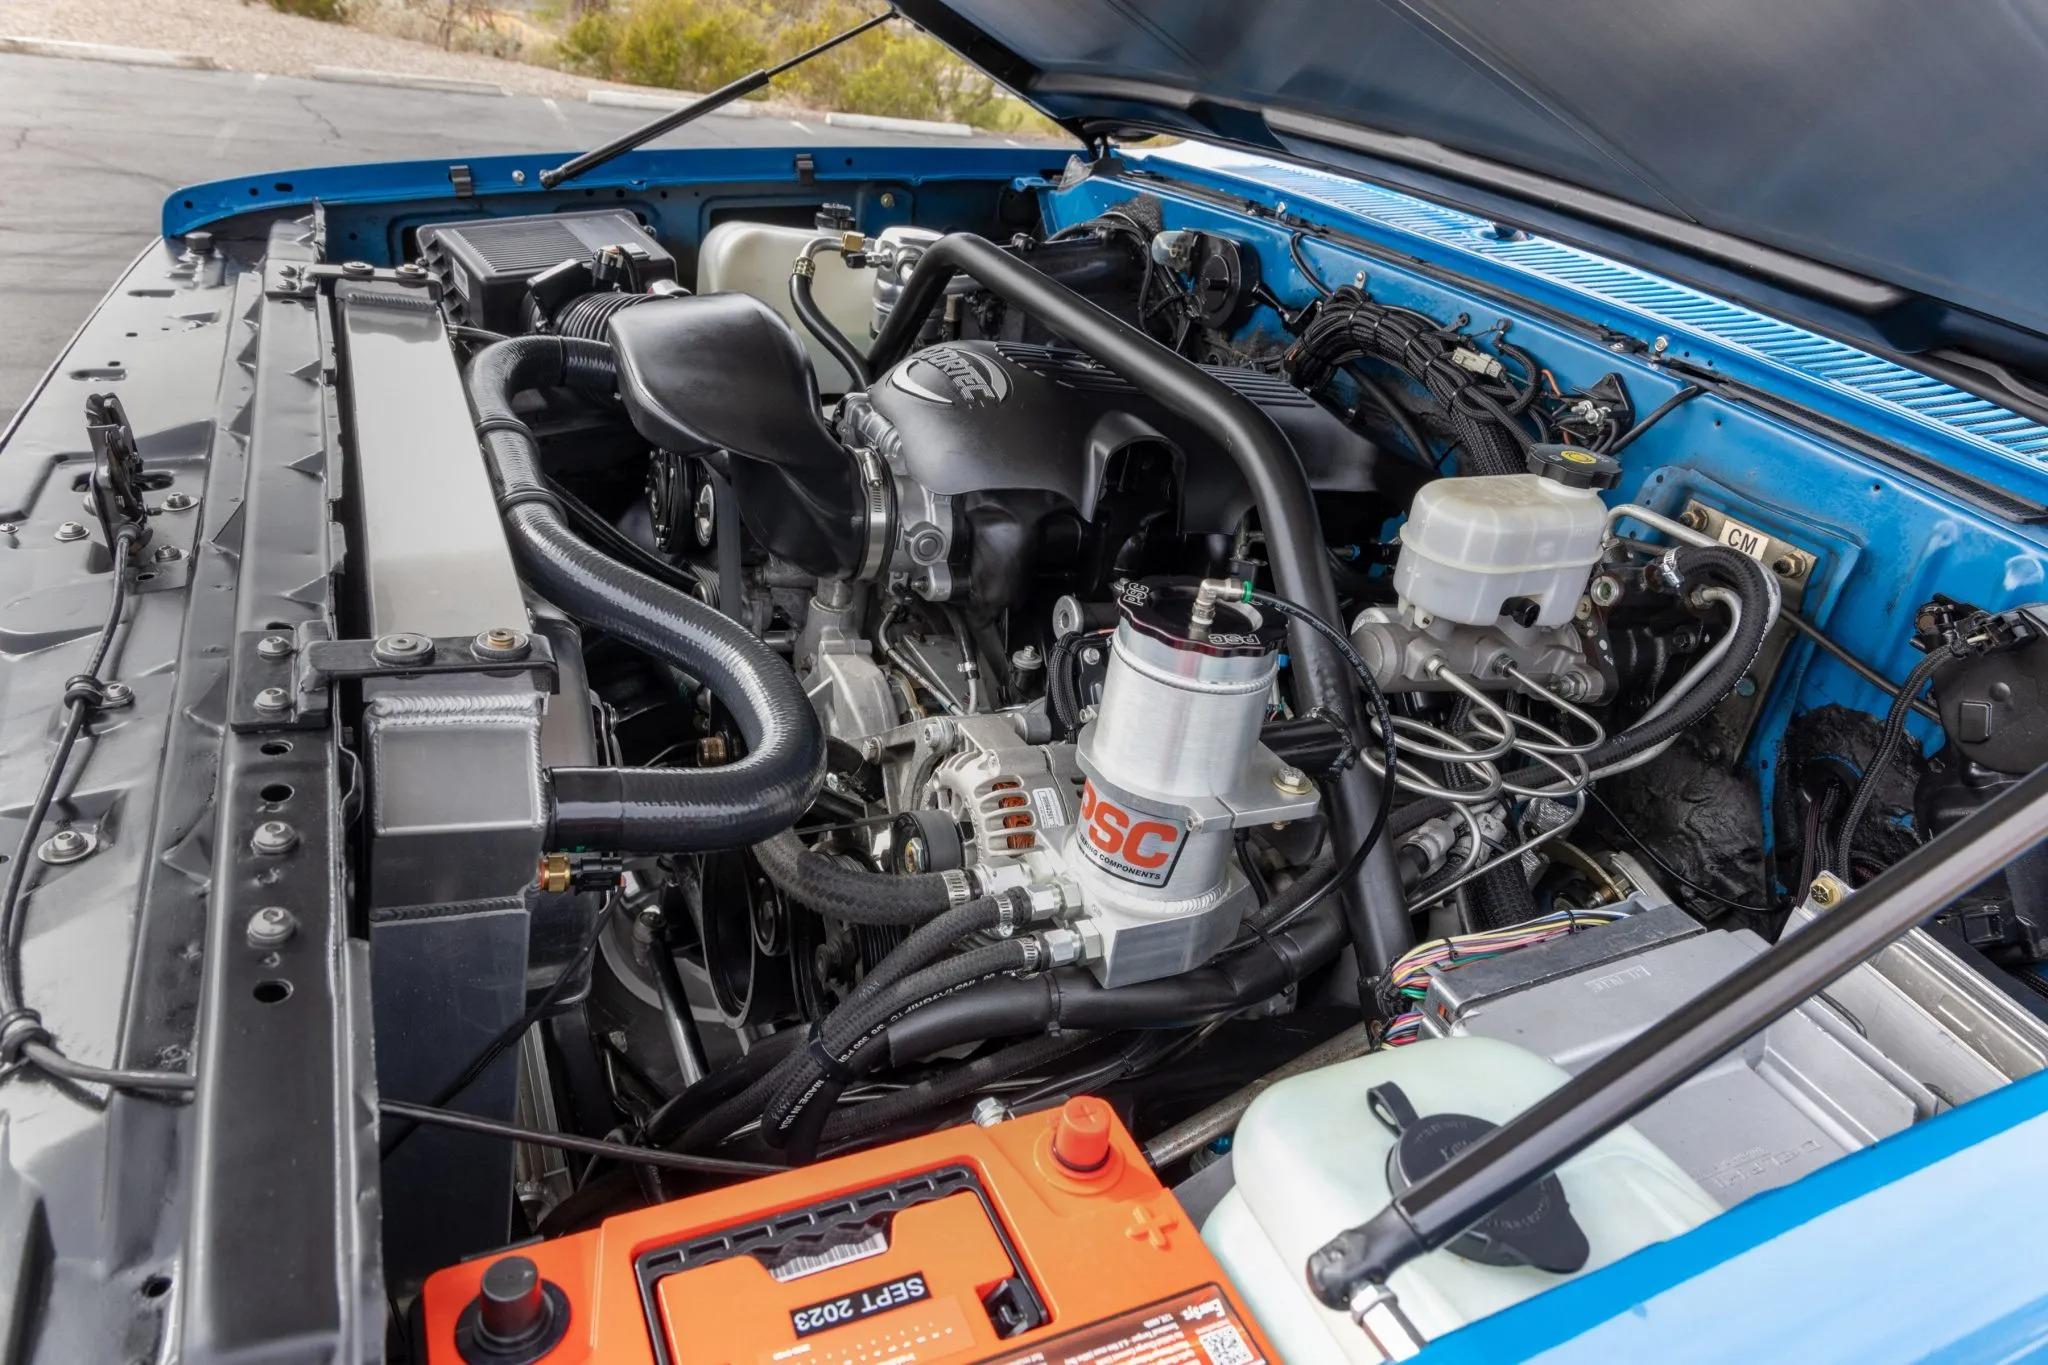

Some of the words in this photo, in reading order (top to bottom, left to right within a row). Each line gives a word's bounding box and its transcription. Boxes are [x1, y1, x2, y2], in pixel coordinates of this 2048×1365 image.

[1728, 528, 1758, 555] CM
[1123, 583, 1149, 606] PSC
[1208, 633, 1260, 645] PSC
[1100, 854, 1161, 880] COMPONENTS
[798, 1080, 825, 1104] MADE
[790, 1105, 803, 1114] IN
[779, 1115, 796, 1130] USA
[861, 1277, 925, 1314] SEPT
[794, 1299, 853, 1331] 2023
